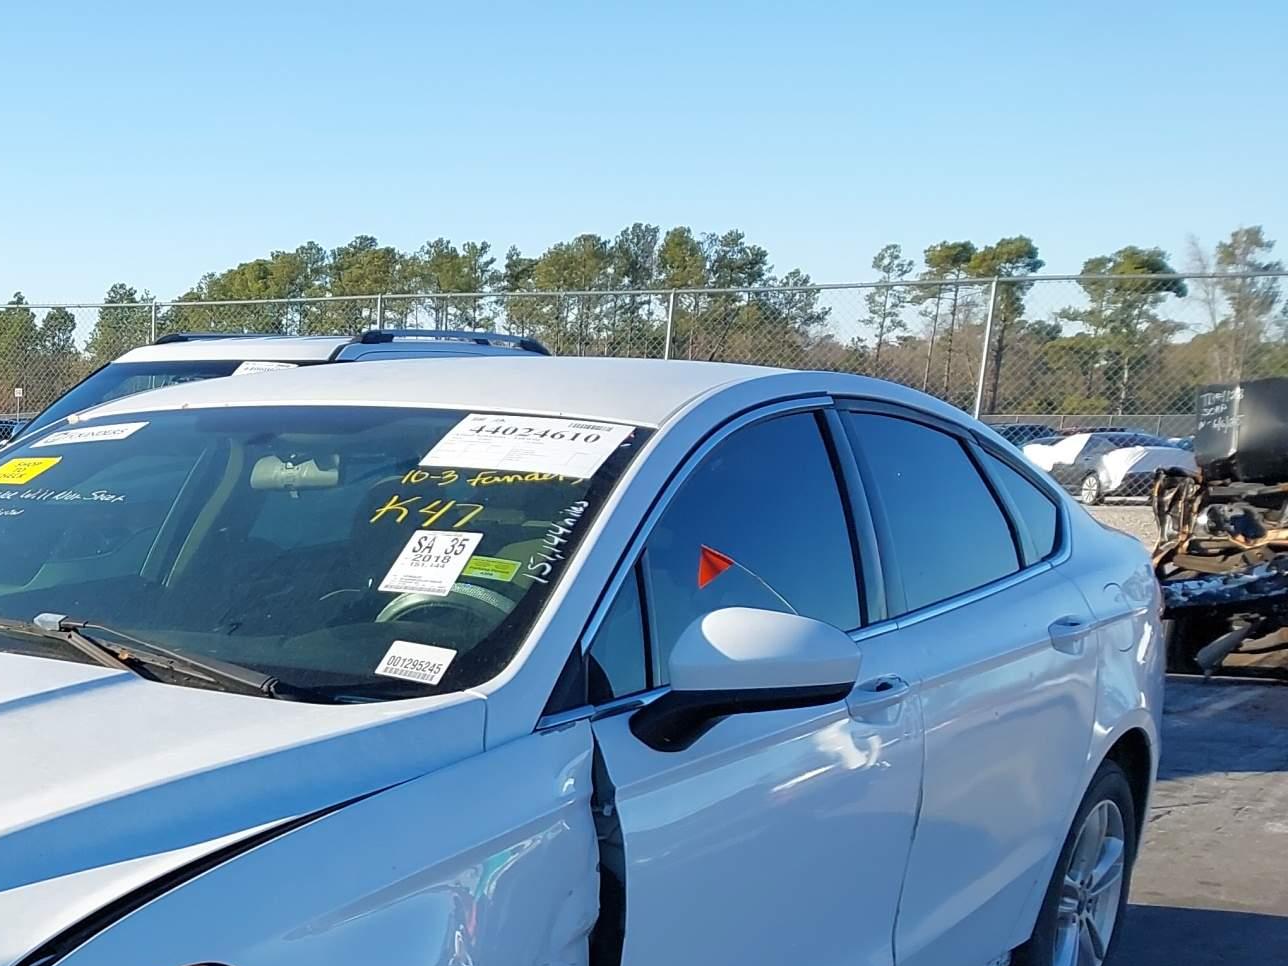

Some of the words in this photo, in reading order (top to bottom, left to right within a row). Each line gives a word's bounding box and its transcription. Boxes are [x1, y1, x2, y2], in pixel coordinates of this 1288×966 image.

[469, 425, 601, 443] 44024610
[401, 469, 459, 487] 10-3
[412, 535, 437, 554] SA
[444, 537, 470, 556] 35
[411, 553, 452, 564] 2018
[387, 655, 444, 674] 001295245
